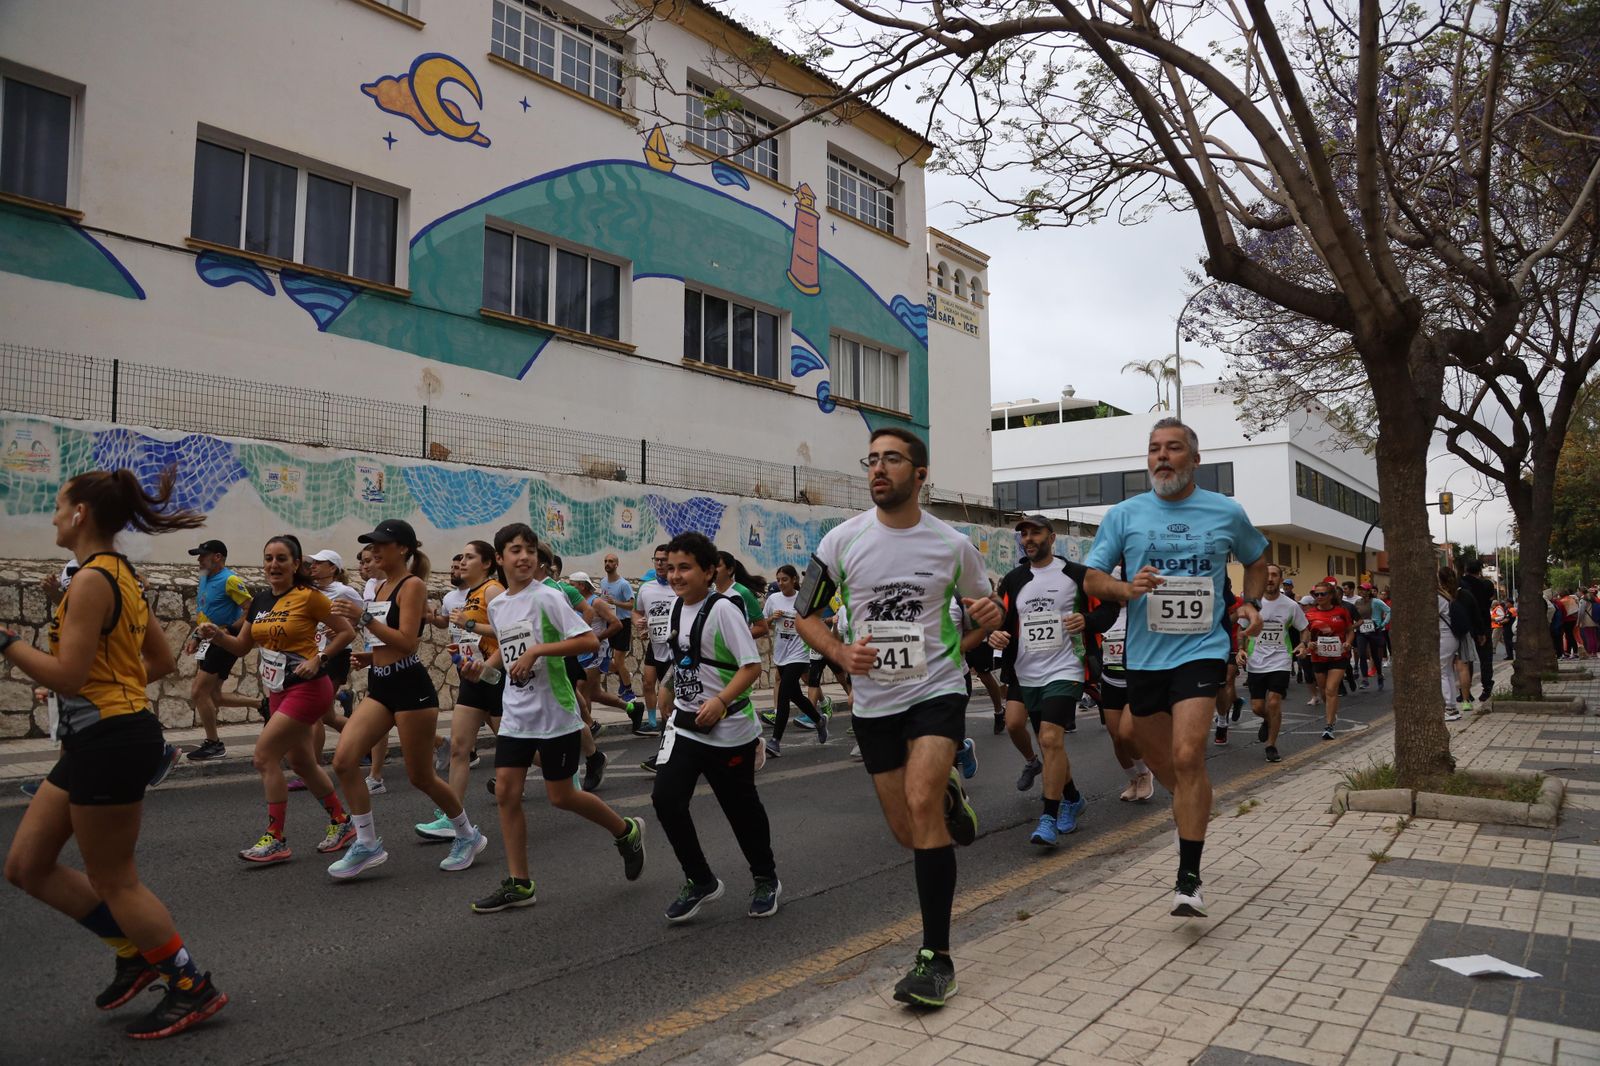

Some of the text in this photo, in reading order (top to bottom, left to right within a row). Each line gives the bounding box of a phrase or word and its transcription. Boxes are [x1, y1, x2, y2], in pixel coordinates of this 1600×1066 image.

[938, 311, 956, 326] SAFA
[963, 321, 978, 335] ICET
[1149, 555, 1212, 574] nerja
[1161, 600, 1203, 619] 519
[1028, 627, 1055, 641] 522
[1261, 632, 1280, 641] 417
[503, 641, 527, 663] 524
[1322, 644, 1337, 652] 301
[373, 665, 391, 677] PRO
